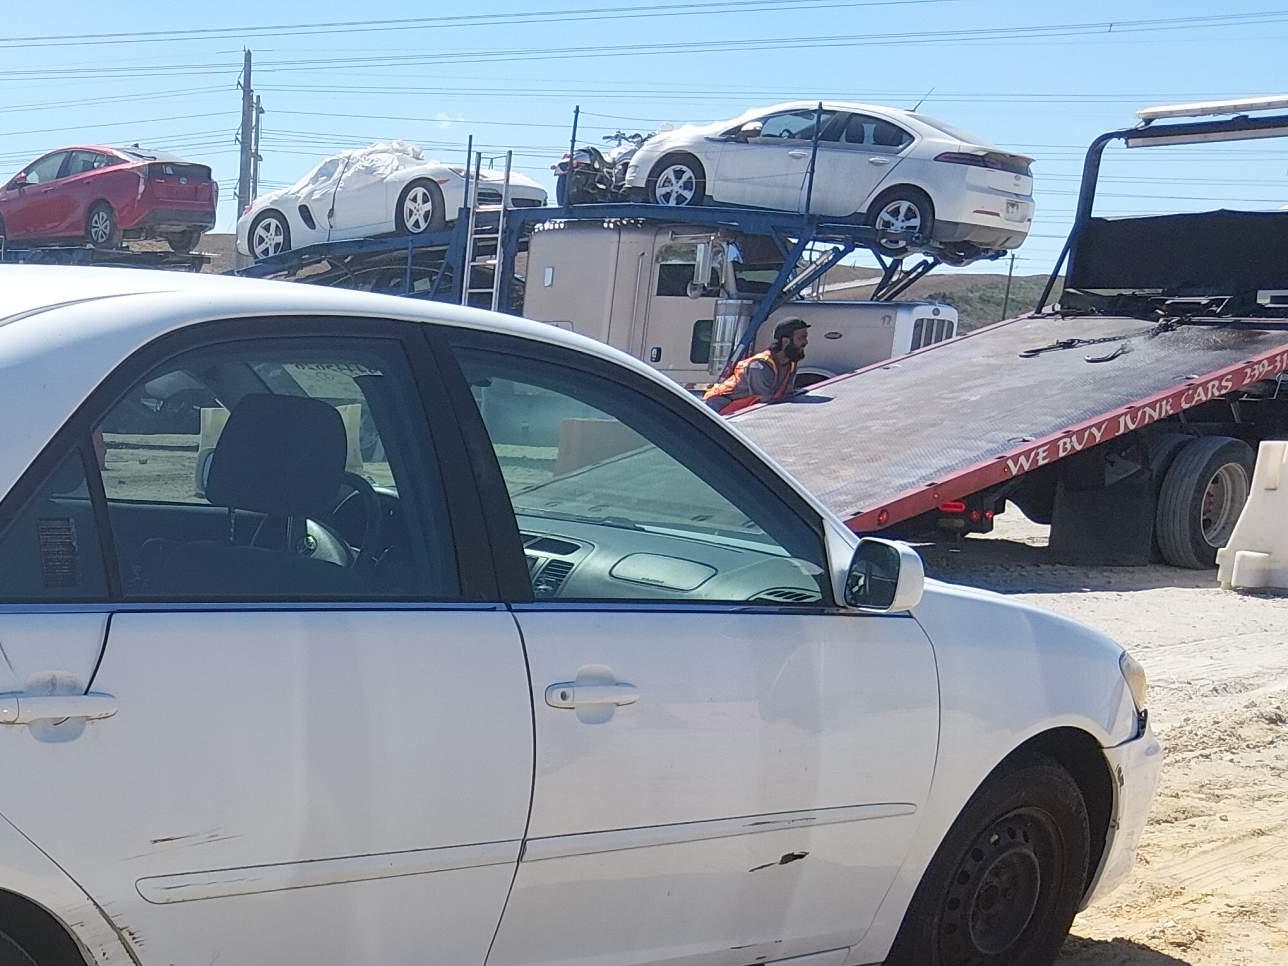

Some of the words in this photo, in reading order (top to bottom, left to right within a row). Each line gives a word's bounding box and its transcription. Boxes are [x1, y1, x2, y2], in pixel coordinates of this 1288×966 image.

[1006, 444, 1050, 476] WE
[1057, 421, 1108, 457] BUY
[1115, 398, 1174, 436] JUNK
[1180, 374, 1233, 409] CARS
